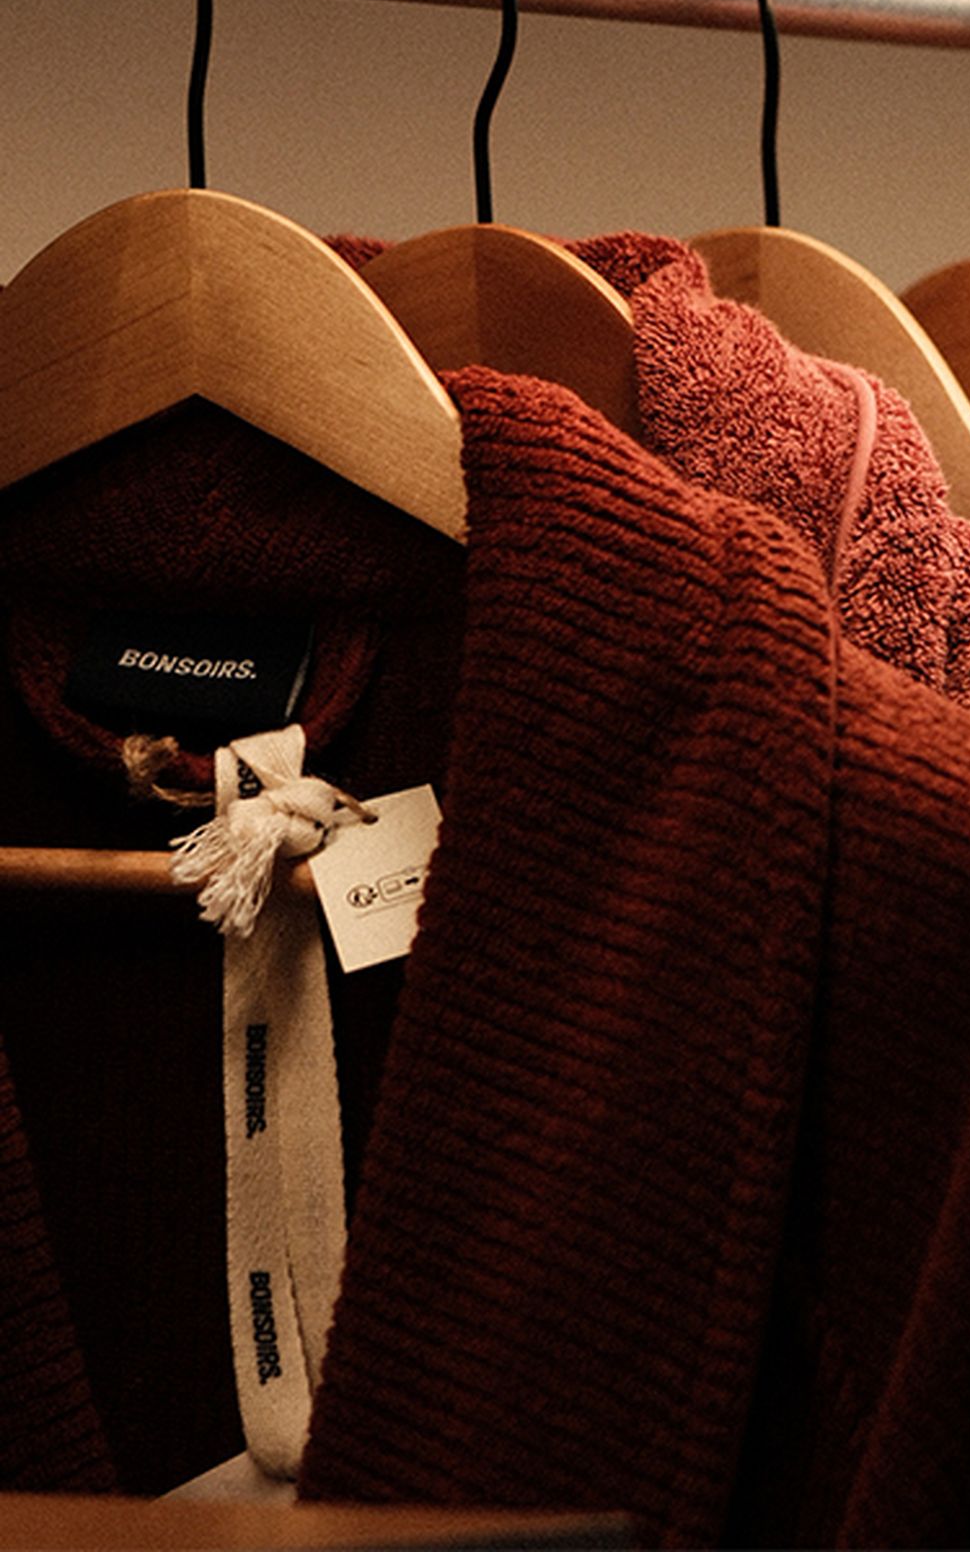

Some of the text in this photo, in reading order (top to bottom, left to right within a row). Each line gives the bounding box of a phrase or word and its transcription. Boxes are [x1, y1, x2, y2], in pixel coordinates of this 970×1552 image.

[118, 648, 257, 679] BONSOIRS.
[246, 1024, 267, 1139] BONSOIRS.
[249, 1272, 282, 1385] BONSOIRS.
